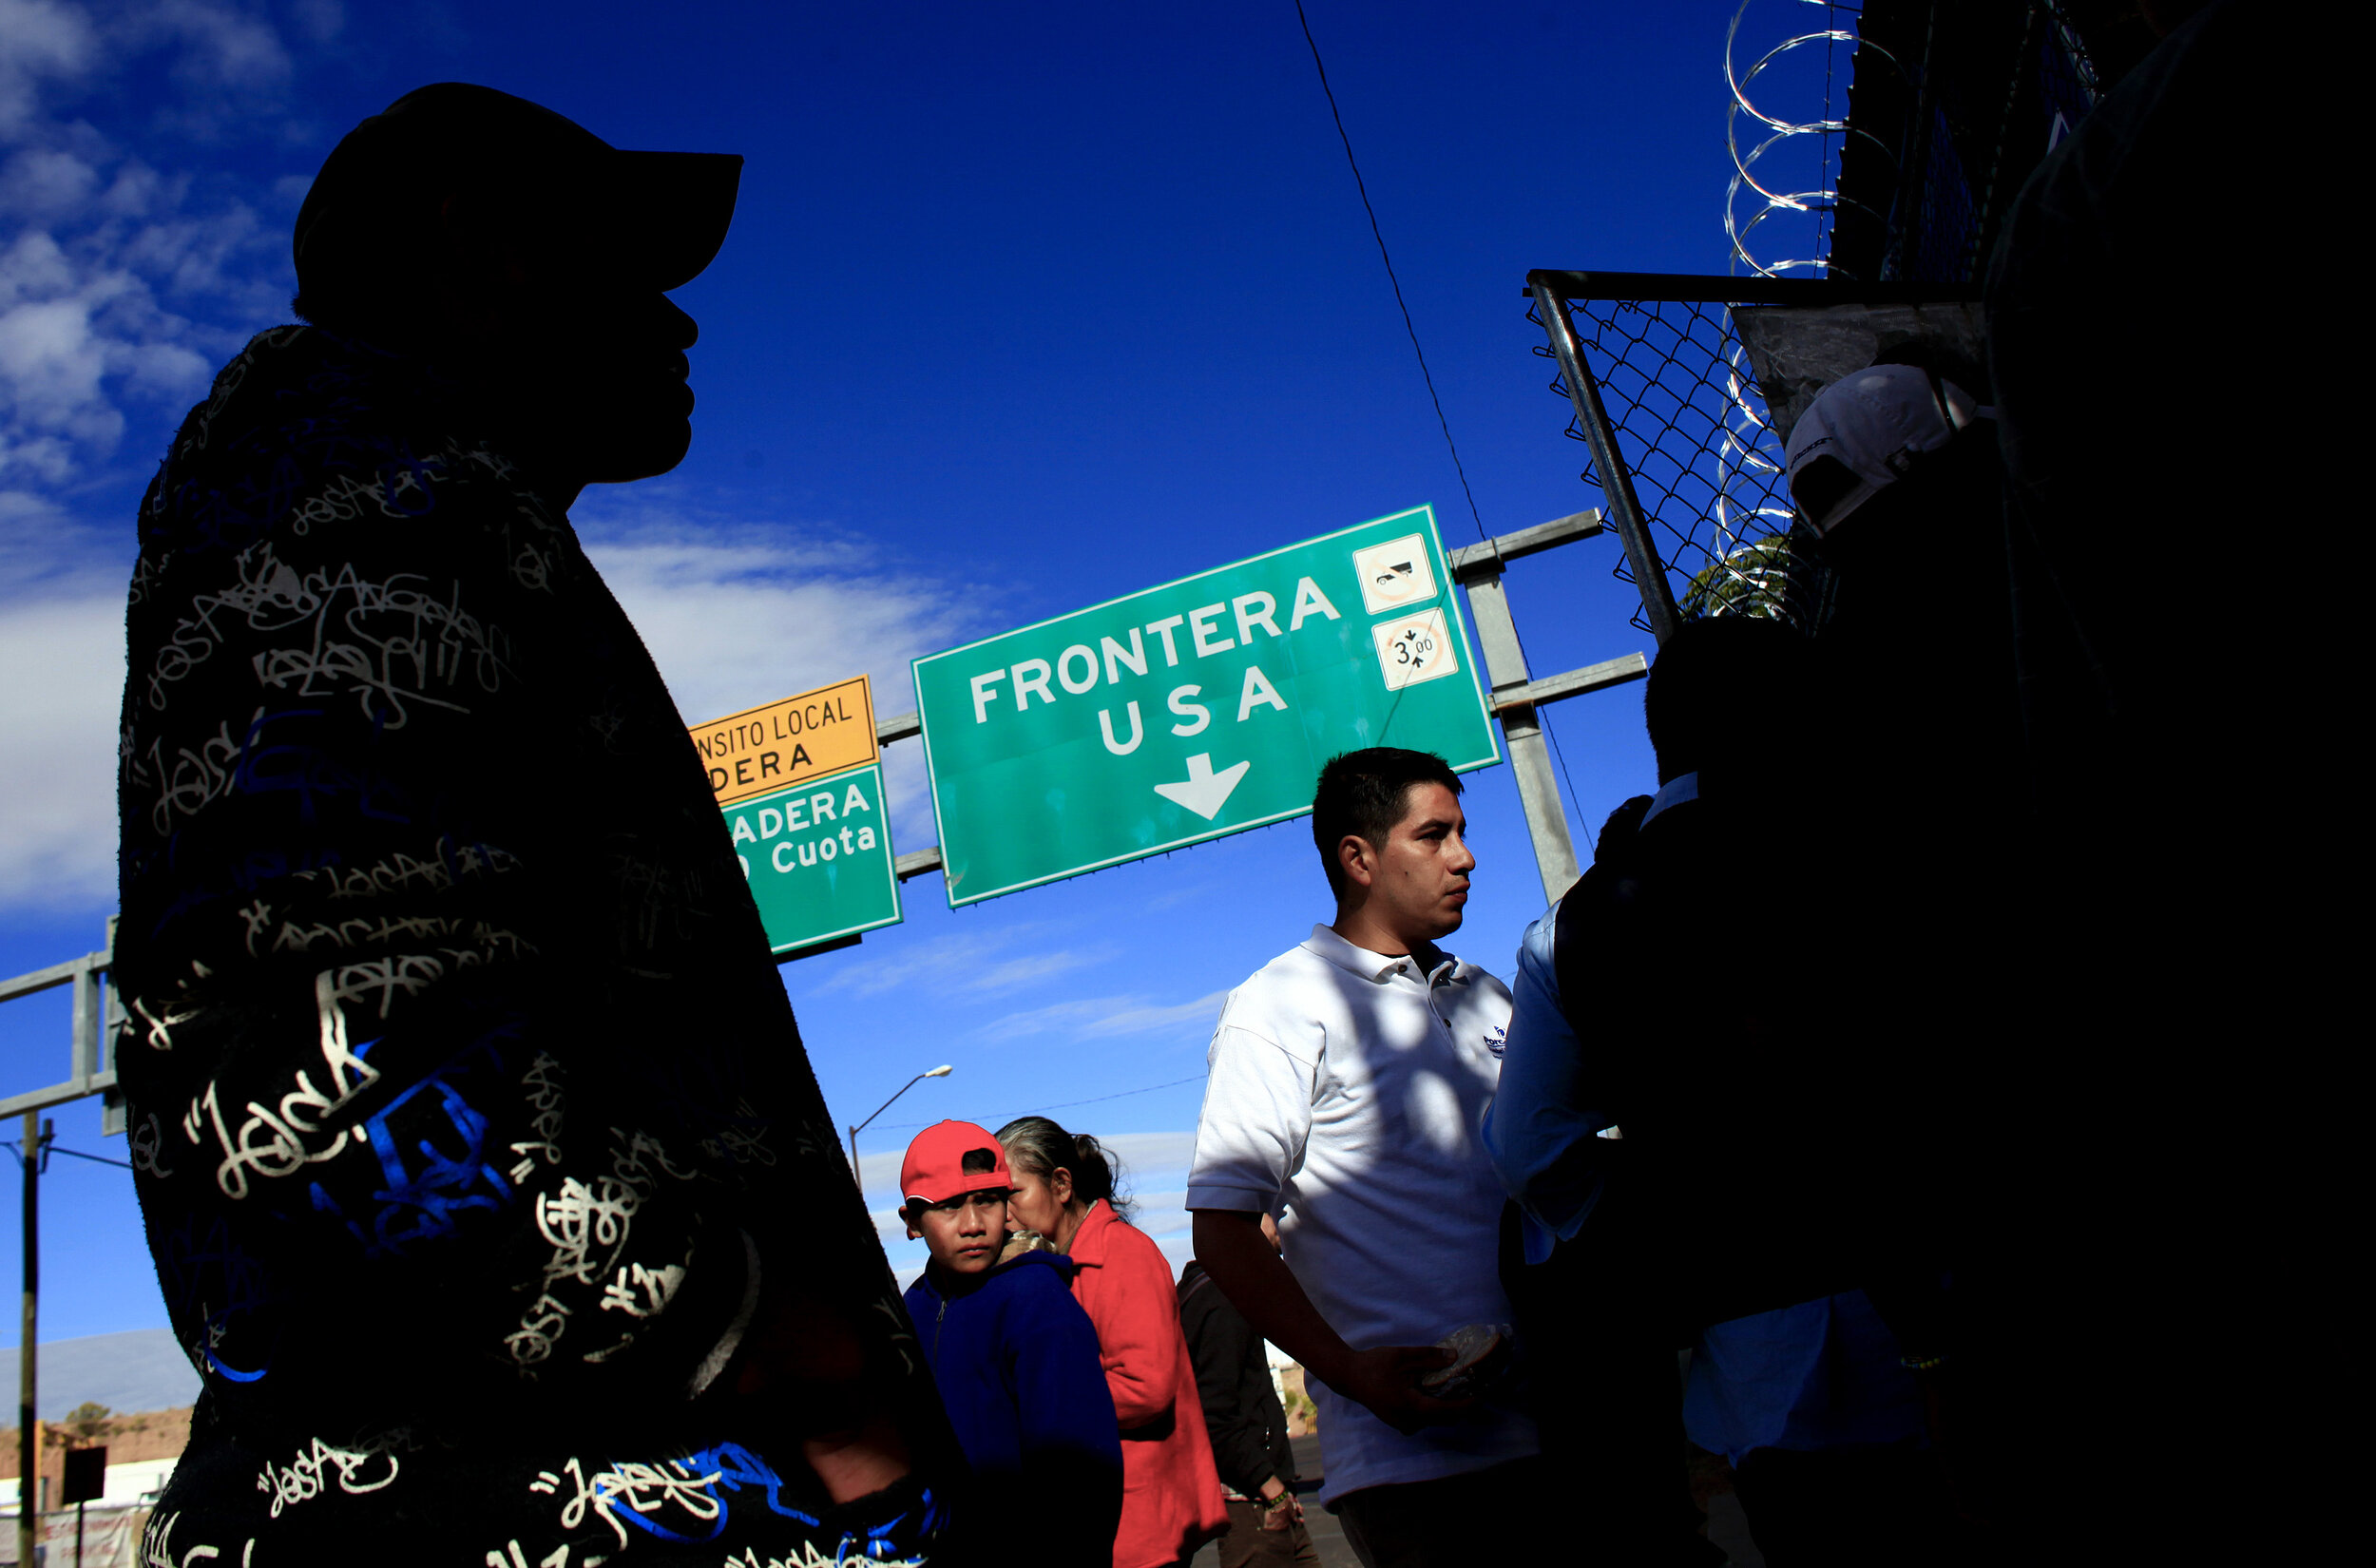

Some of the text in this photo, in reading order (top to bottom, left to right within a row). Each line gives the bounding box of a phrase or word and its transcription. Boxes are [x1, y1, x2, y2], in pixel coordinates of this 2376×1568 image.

[969, 576, 1342, 724] FRONTERA
[774, 697, 853, 740] LOCAL
[772, 826, 876, 873] Cuota
